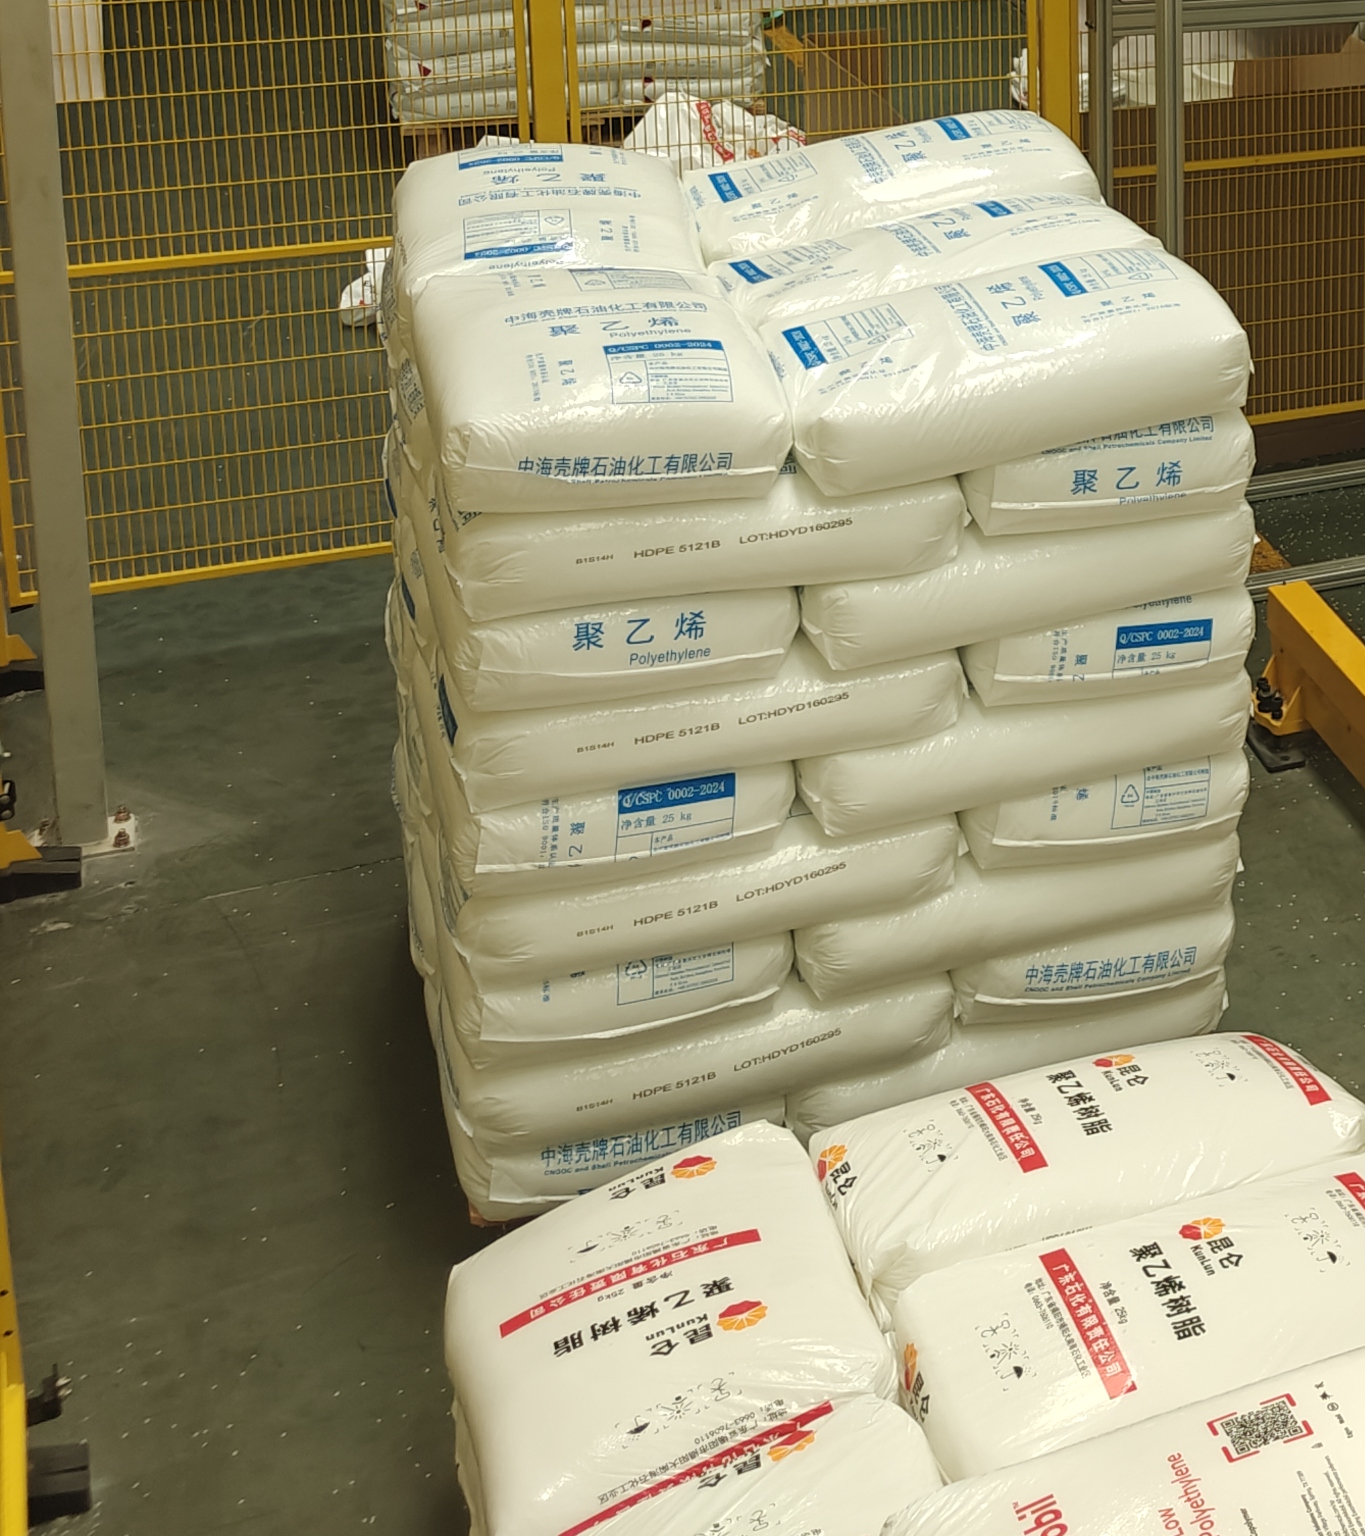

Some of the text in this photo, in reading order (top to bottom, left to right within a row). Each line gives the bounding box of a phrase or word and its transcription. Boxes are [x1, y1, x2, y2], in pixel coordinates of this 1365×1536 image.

[549, 315, 680, 337] 聚乙烯
[609, 327, 692, 339] Polyethylene
[517, 452, 734, 478] 中海壳牌石油化工有限公司
[1070, 459, 1184, 496] 聚乙烯
[633, 545, 675, 560] HDPE
[678, 539, 721, 554] 5121B
[739, 517, 853, 545] LOT:HDYD160295
[572, 609, 707, 652] 聚乙烯
[1118, 625, 1205, 645] Q/CSPC 0002-2024
[629, 645, 712, 666] Polyethylene
[1117, 651, 1147, 664] 净含量
[633, 730, 675, 746] HDPE
[678, 722, 721, 738] 5121B
[738, 691, 851, 726] LOT:HDYD160295
[622, 780, 726, 807] Q/CSPC 0002-2024
[621, 811, 693, 831] 净含量 25 kg
[633, 910, 674, 927] HDPE
[676, 899, 719, 917] 5121B
[735, 862, 848, 903] LOT:HDYD160295
[1025, 945, 1198, 986] 中海壳牌石油化工有限公司
[632, 1083, 673, 1101] HDPE
[675, 1071, 717, 1090] 5121B
[733, 1027, 843, 1073] LOT:HDYD160295
[1117, 1064, 1150, 1087] 昆仑
[1045, 1069, 1113, 1137] 聚乙烯树脂
[540, 1110, 743, 1168] 中海壳牌石油化工有限公司
[608, 1172, 667, 1201] 昆仑
[1189, 1243, 1216, 1277] KunLun
[1206, 1236, 1244, 1269] 昆仑
[529, 1237, 729, 1320] 广东石化有限责任公司
[597, 1287, 626, 1303] 25kg
[1100, 1280, 1121, 1307] 净含量
[1129, 1241, 1207, 1341] 聚乙烯树脂
[552, 1276, 736, 1359] 聚乙烯树脂
[645, 1312, 709, 1342] KunLun
[1052, 1262, 1122, 1378] 广东石化有限责任公司
[649, 1322, 715, 1357] 昆仑
[698, 1450, 764, 1491] 昆仑
